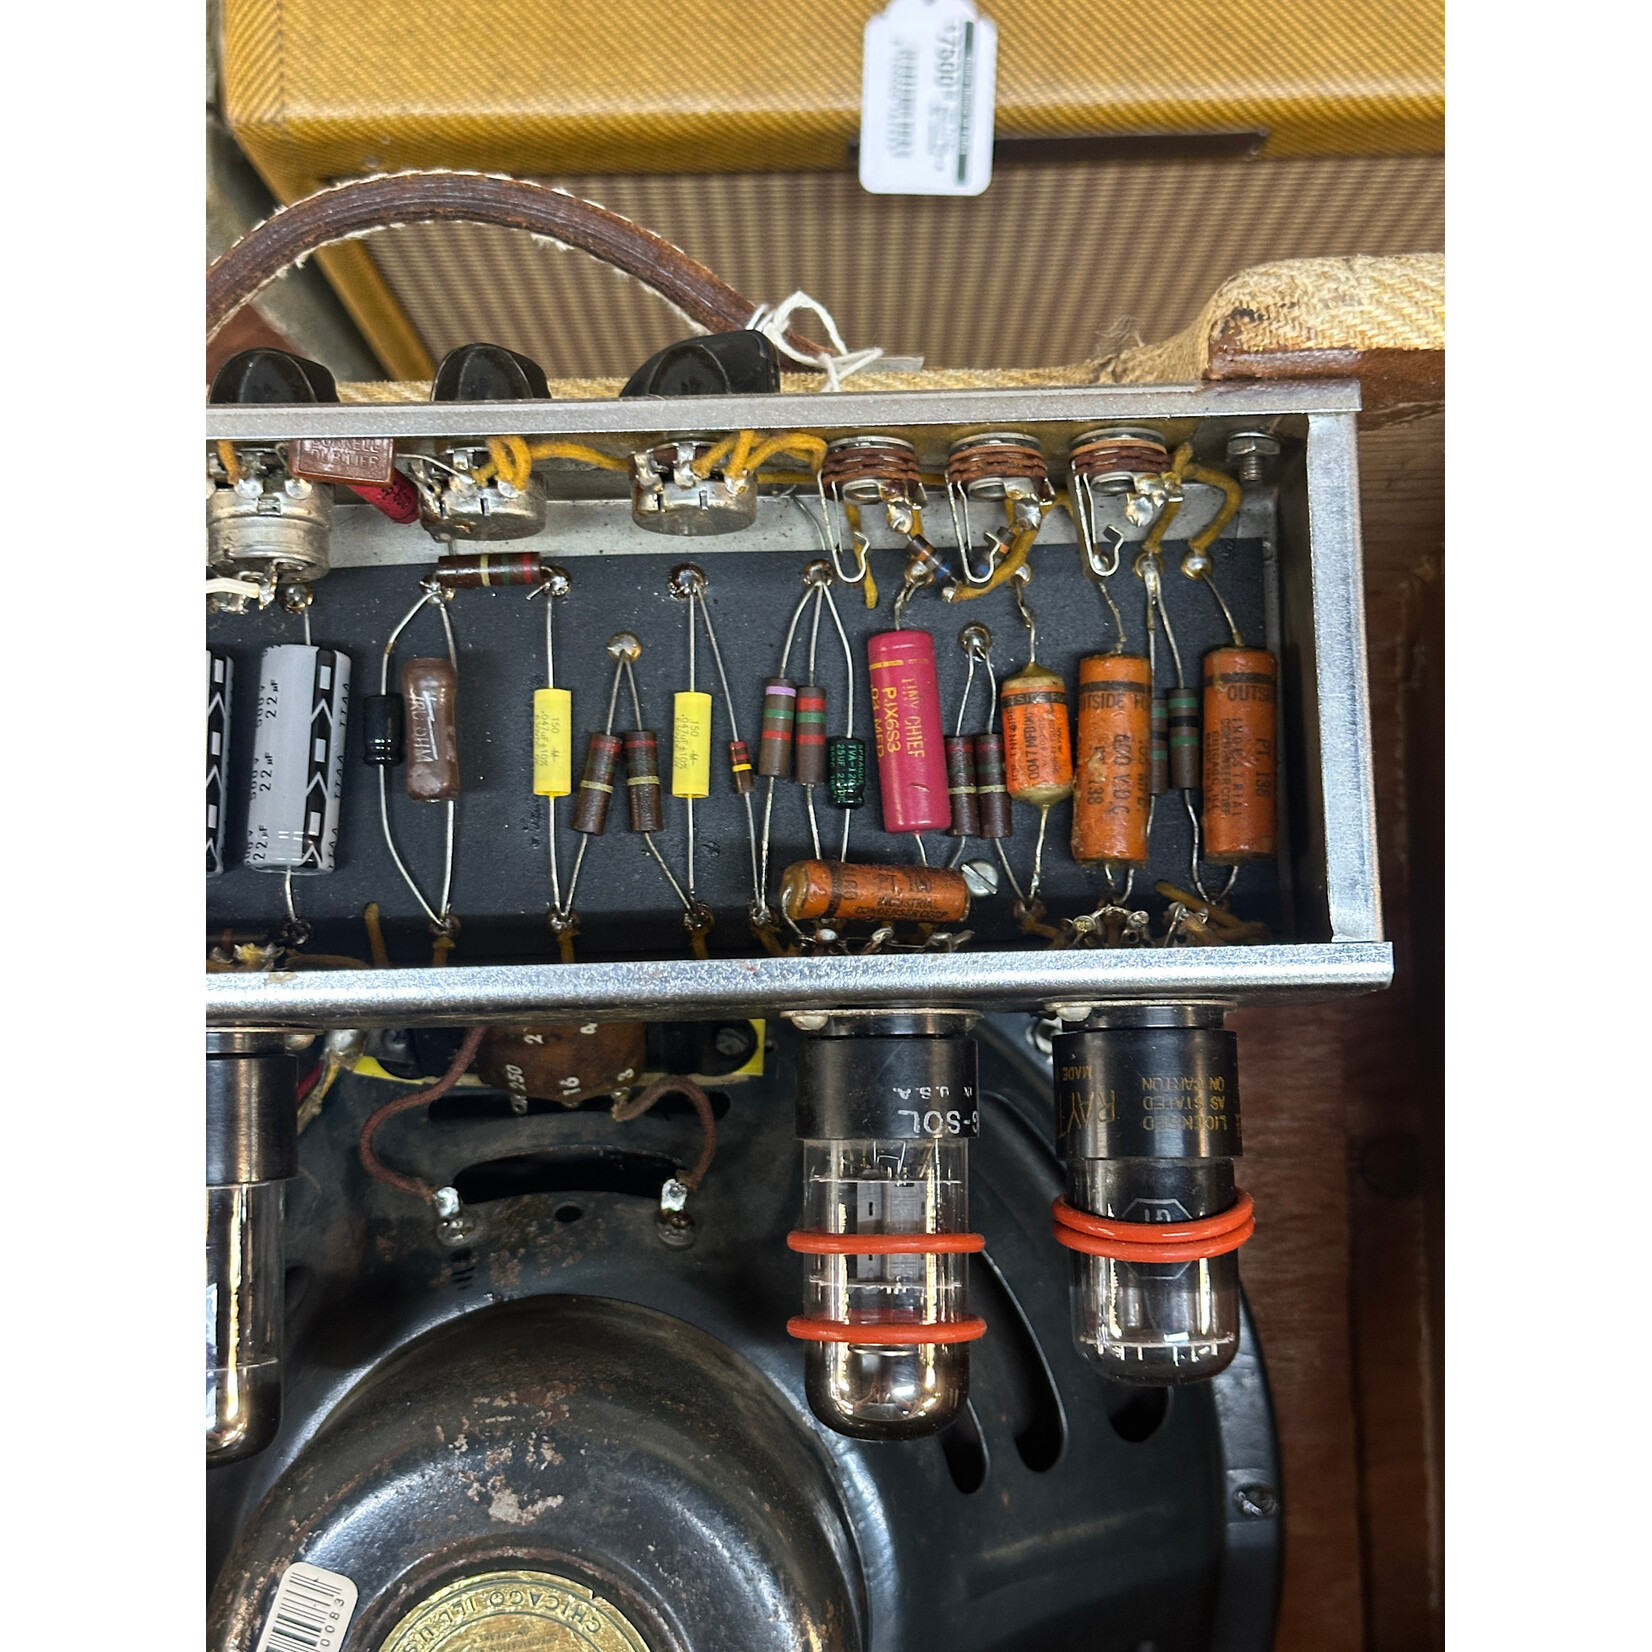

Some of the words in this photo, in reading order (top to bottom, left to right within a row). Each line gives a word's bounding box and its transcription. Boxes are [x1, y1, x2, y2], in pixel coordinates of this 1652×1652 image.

[905, 715, 925, 758] CHIEF
[524, 1034, 544, 1045] 2
[559, 1076, 582, 1096] 16
[1209, 1095, 1225, 1110] AS
[1142, 1115, 1228, 1132] LICENSED
[489, 1590, 602, 1634] CHICAGO
